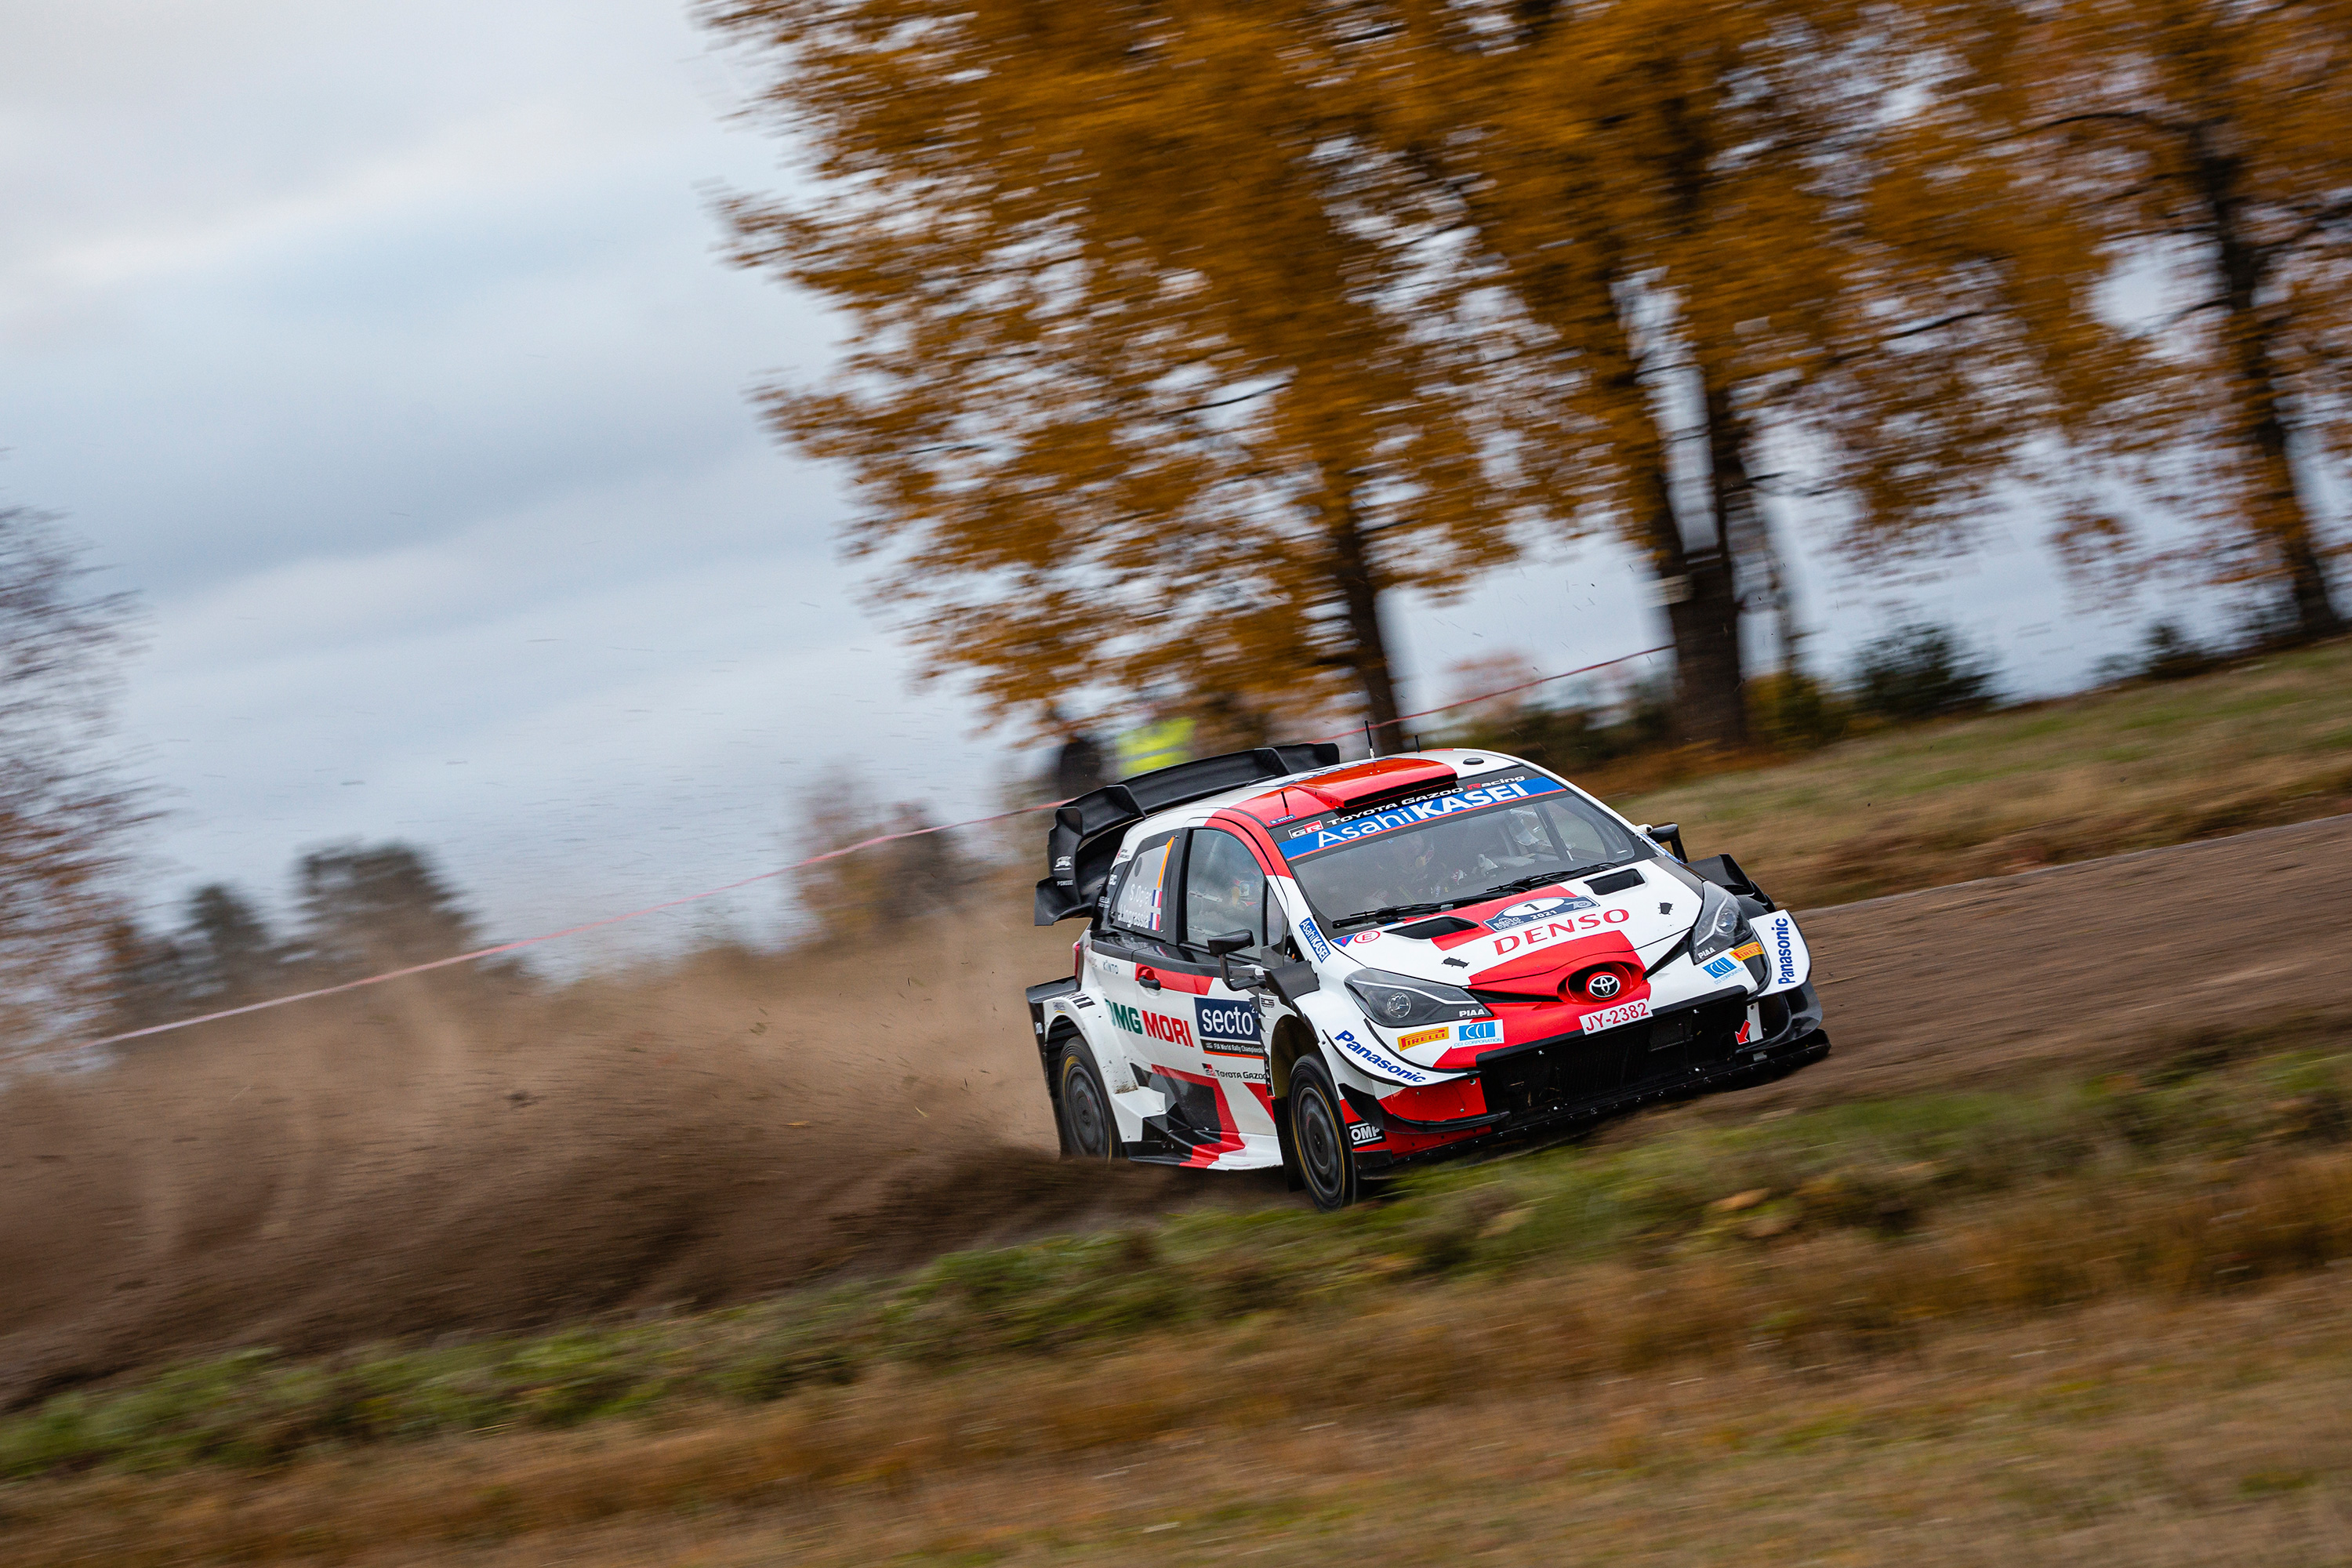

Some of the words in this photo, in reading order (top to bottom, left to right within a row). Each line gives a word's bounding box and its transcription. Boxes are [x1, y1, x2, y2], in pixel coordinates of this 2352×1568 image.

[1327, 803, 1397, 825] TOYOTA
[1401, 787, 1464, 805] GAZOO
[1467, 775, 1526, 791] Racing
[1292, 823, 1323, 837] GR
[1530, 910, 1558, 920] 2021
[1362, 933, 1373, 942] E
[1493, 909, 1630, 956] DENSO
[1697, 946, 1716, 960] PIAA
[1771, 917, 1795, 985] Panasonic
[1202, 1006, 1254, 1036] secto
[1459, 1008, 1486, 1018] PIAA
[1585, 1002, 1650, 1032] JY-2382
[1142, 1010, 1195, 1048] MORI
[1401, 1029, 1446, 1048] PIRELLI
[1465, 1037, 1502, 1046] CORPORATION
[1334, 1030, 1427, 1083] Panasonic
[1215, 1069, 1243, 1079] TOYOTA
